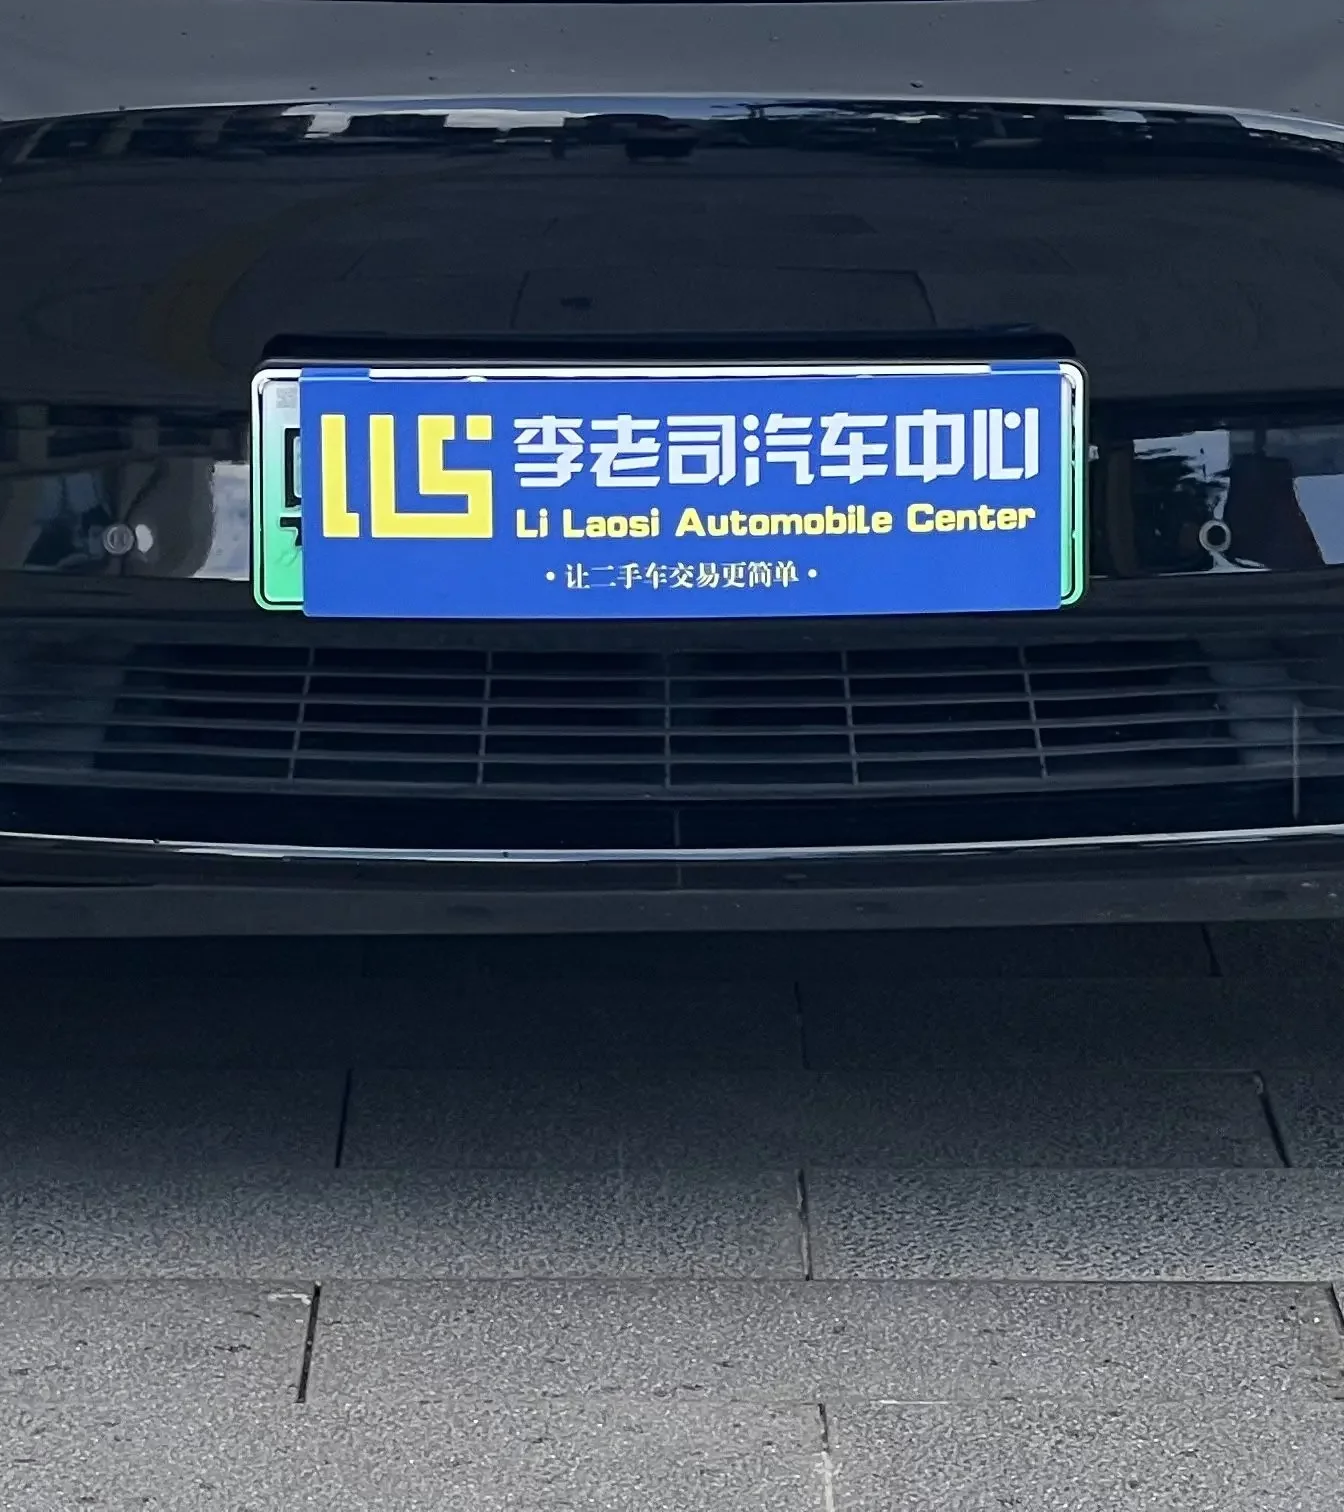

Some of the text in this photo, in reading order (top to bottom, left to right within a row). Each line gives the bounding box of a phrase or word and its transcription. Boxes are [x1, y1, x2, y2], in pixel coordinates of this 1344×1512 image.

[513, 407, 1039, 488] 李老司汽车中心
[516, 502, 1037, 539] Li Laosi Automobile Center
